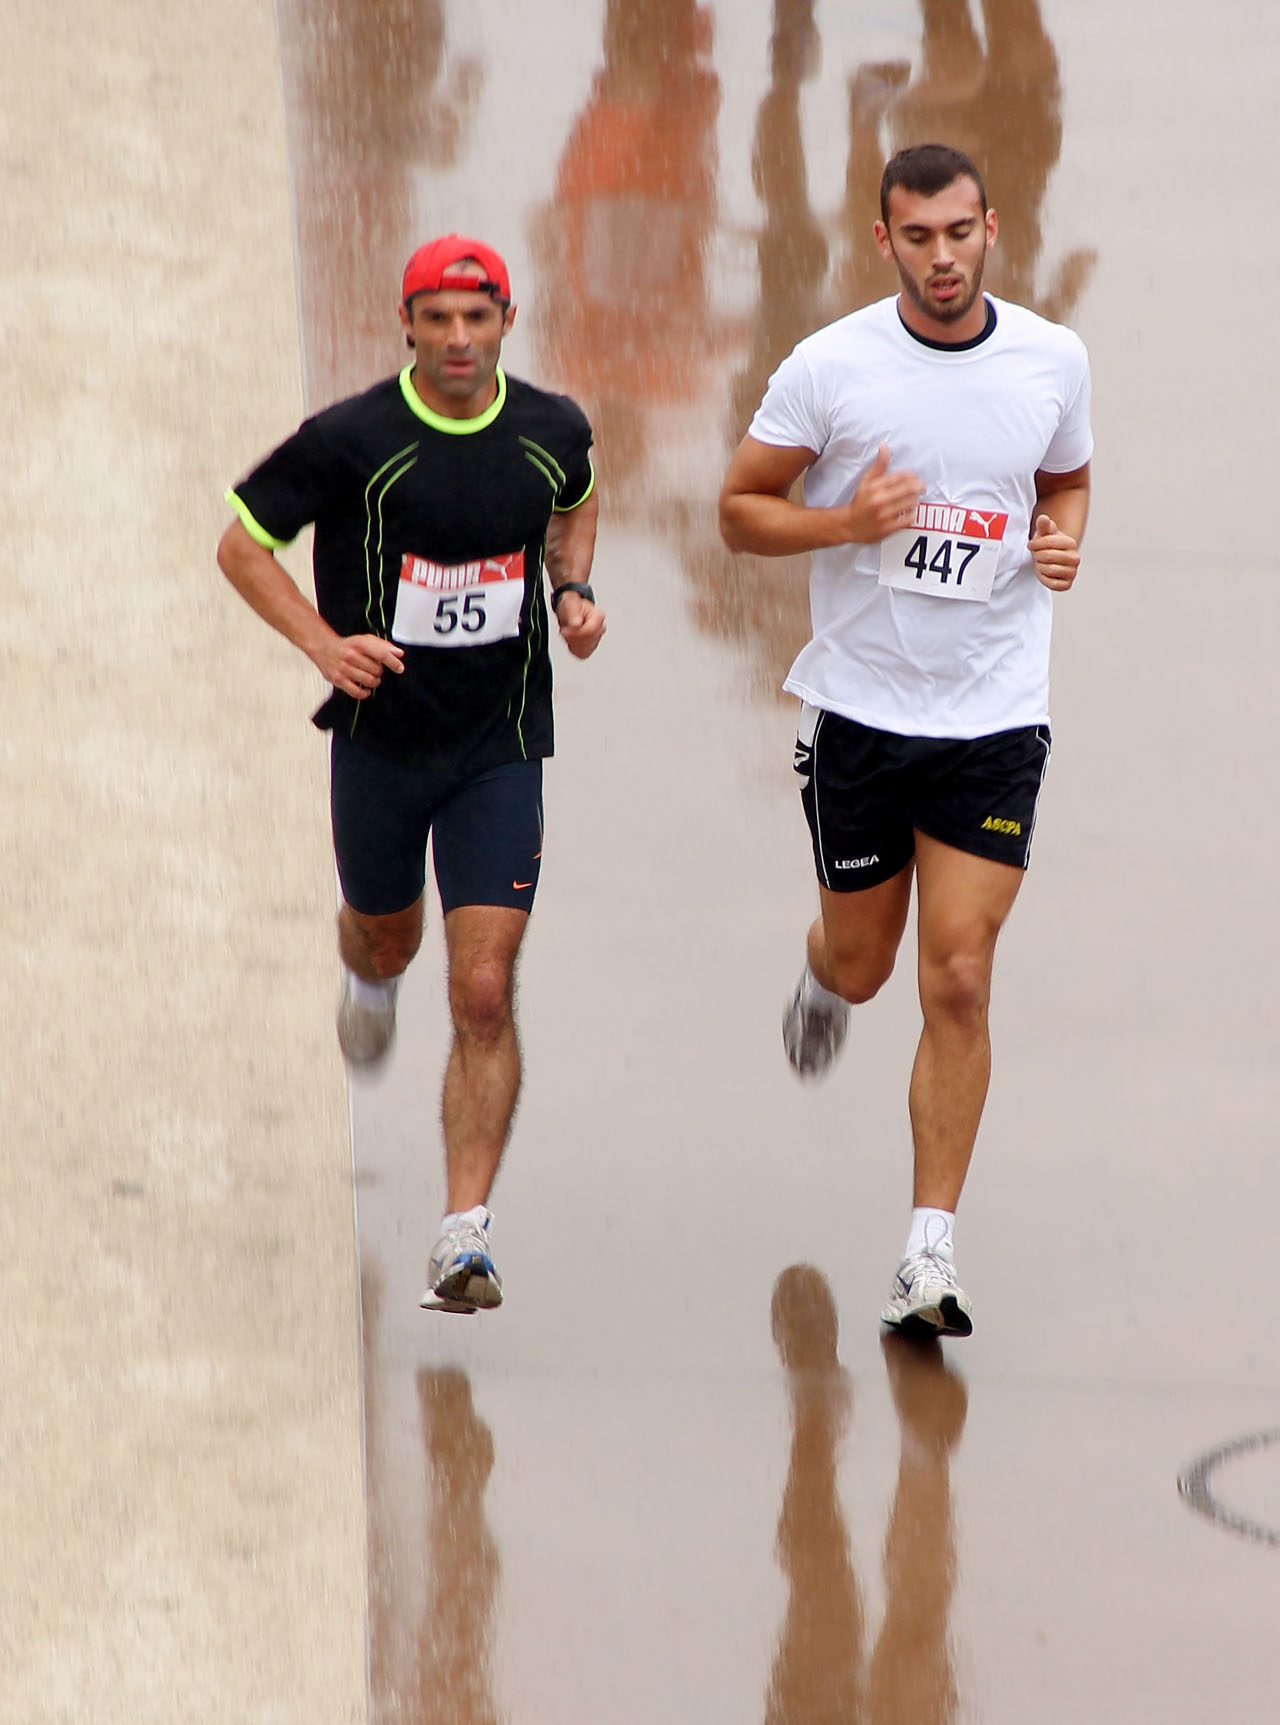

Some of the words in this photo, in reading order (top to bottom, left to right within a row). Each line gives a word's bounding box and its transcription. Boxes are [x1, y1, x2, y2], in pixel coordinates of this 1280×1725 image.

[913, 504, 967, 533] UMA
[410, 557, 481, 590] PUMA
[904, 535, 981, 585] 447
[433, 592, 487, 634] 55
[835, 854, 880, 869] LEGEA
